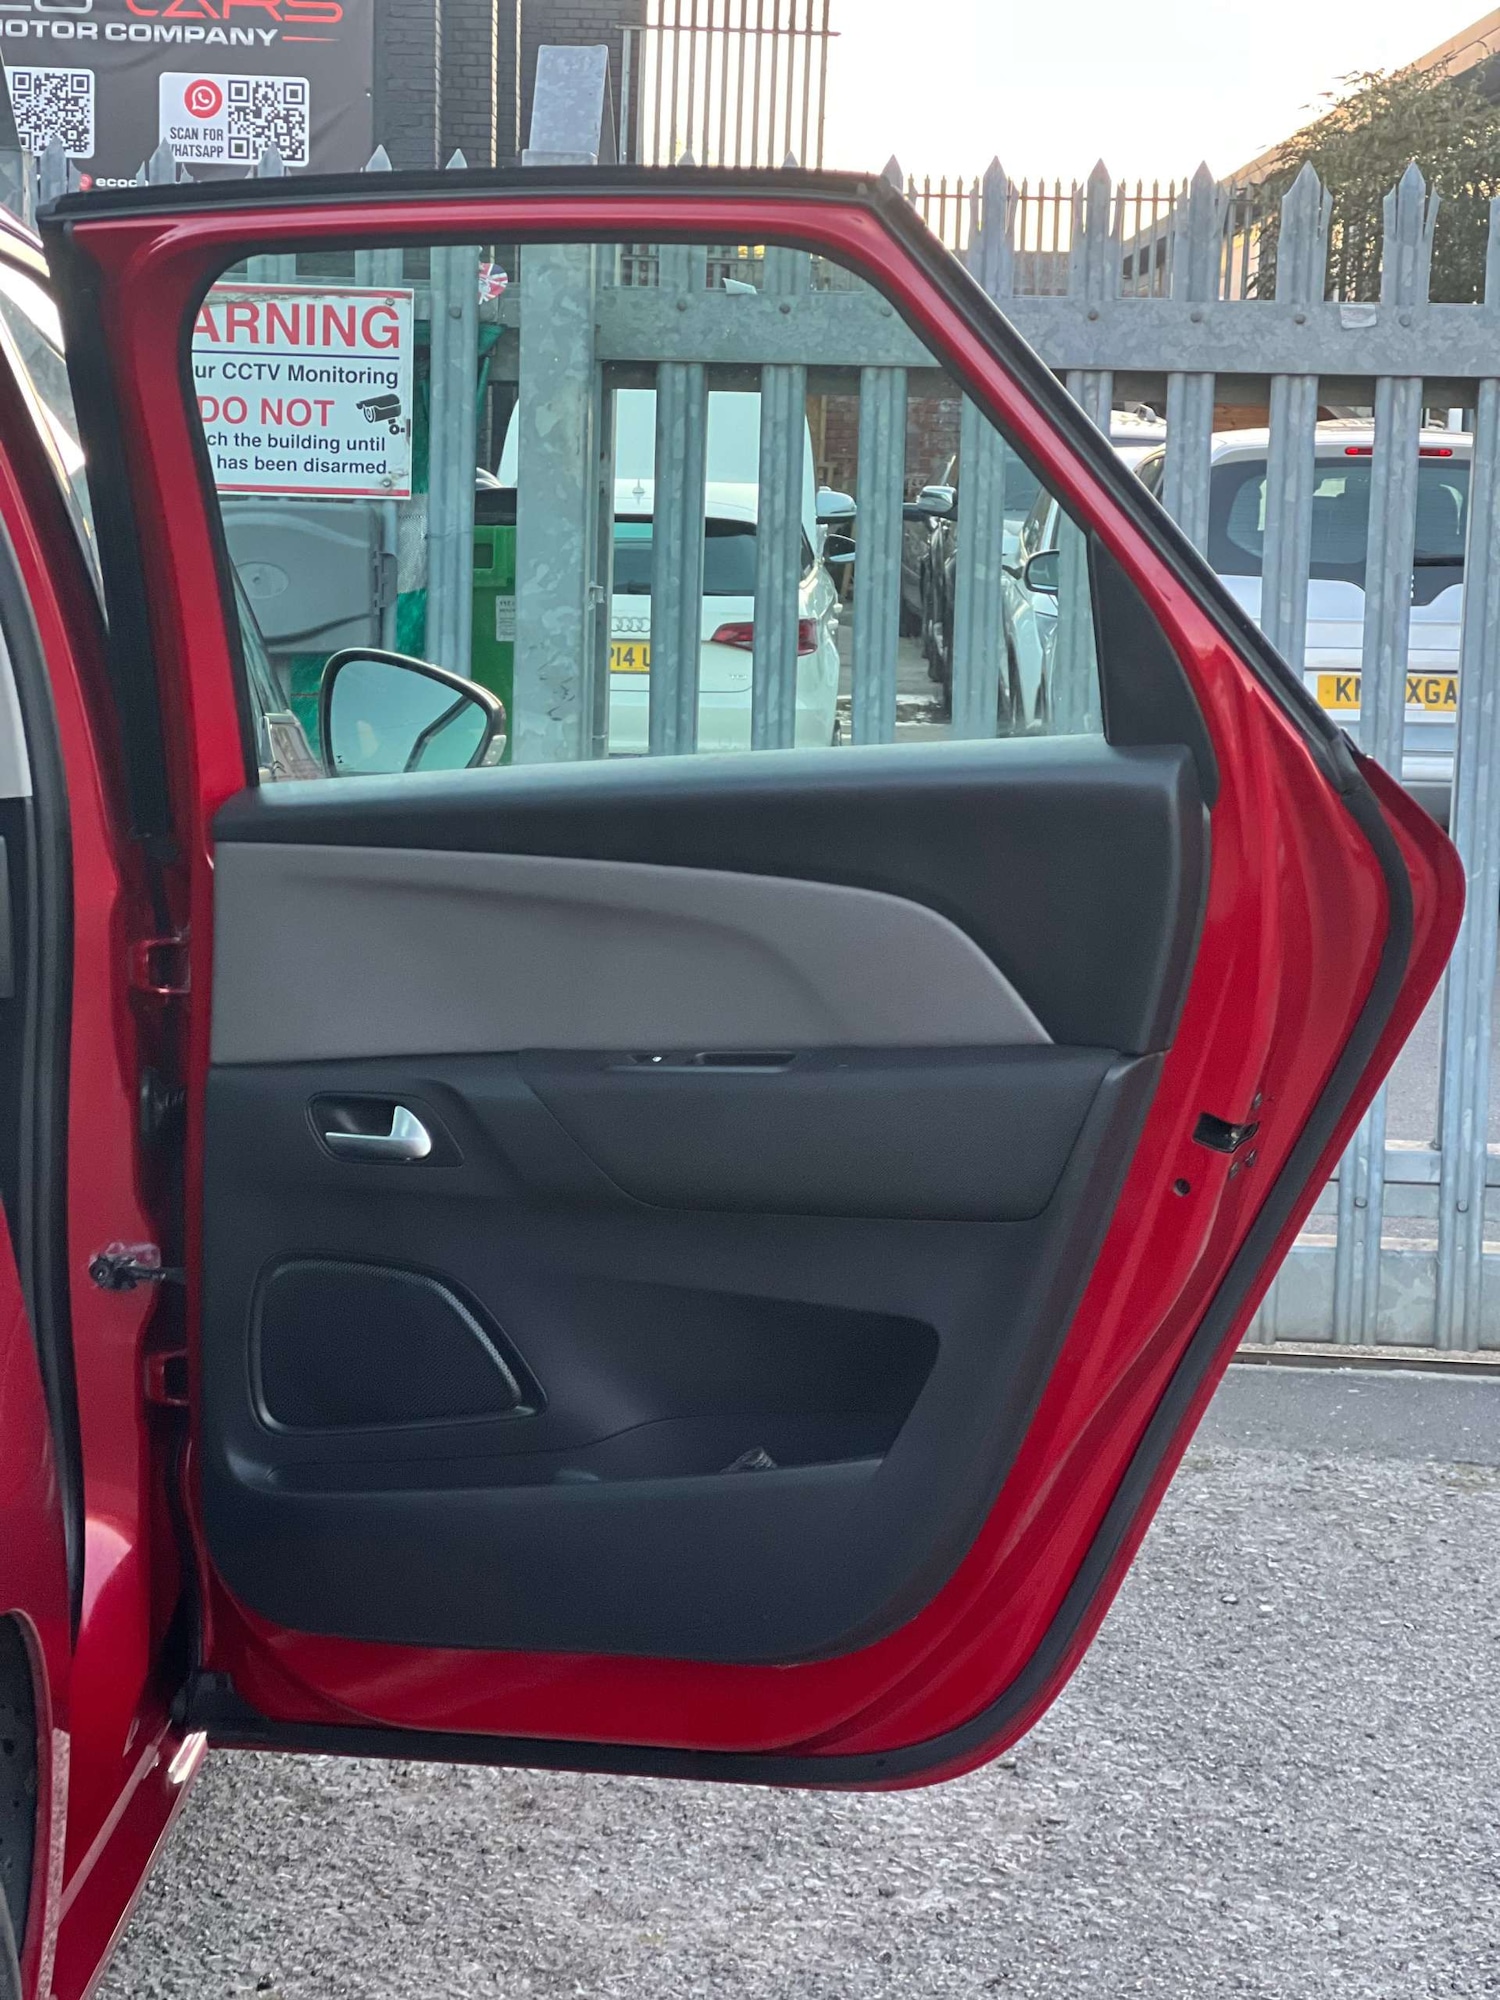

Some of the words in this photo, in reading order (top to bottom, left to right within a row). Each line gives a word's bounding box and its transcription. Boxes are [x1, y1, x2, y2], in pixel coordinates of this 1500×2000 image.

[0, 19, 98, 40] OTOR
[105, 23, 278, 46] COMPANY
[170, 127, 199, 140] SCAN
[203, 128, 223, 141] FOR
[194, 302, 399, 349] ARNING
[195, 364, 215, 378] ur
[222, 362, 281, 381] CCTV
[287, 365, 398, 389] Monitoring
[197, 396, 248, 424] DO
[260, 398, 335, 427] NOT
[233, 434, 261, 447] the
[267, 434, 340, 453] building
[346, 438, 385, 452] until
[217, 455, 248, 470] has
[254, 456, 297, 472] been
[303, 458, 392, 475] disarmed.
[1406, 679, 1457, 704] XGA
